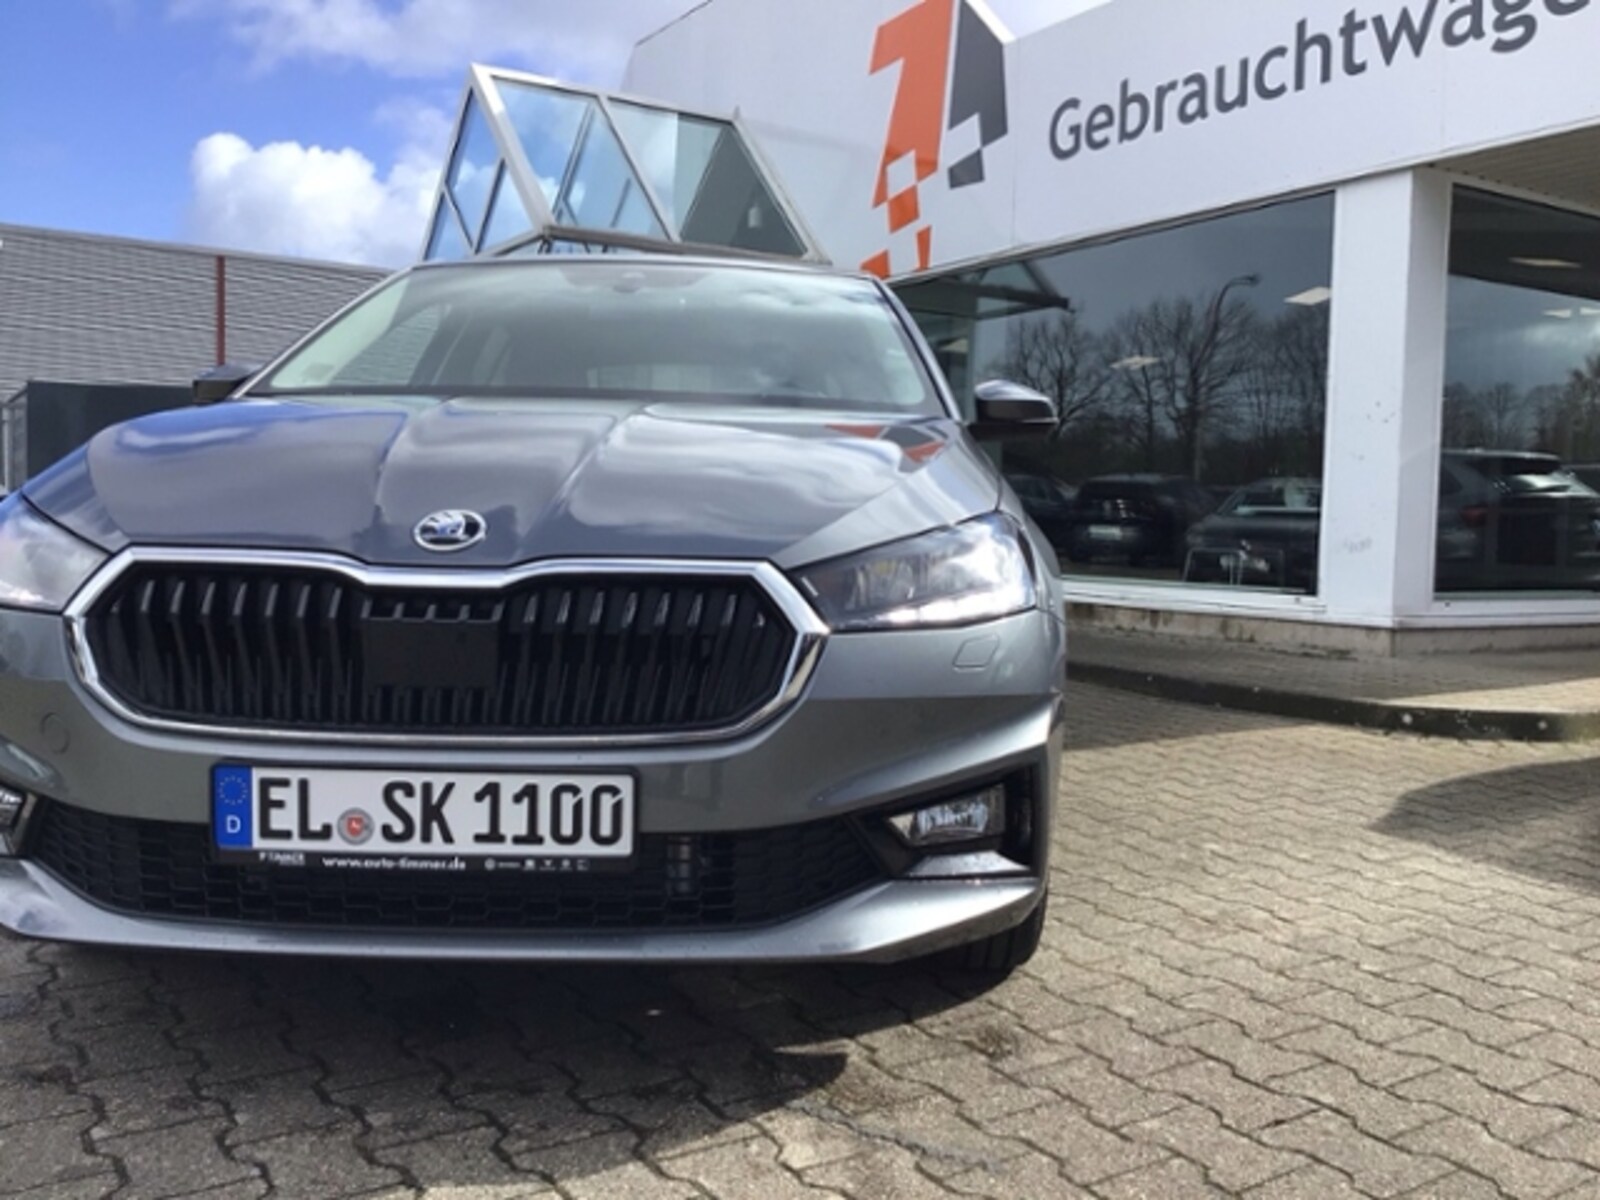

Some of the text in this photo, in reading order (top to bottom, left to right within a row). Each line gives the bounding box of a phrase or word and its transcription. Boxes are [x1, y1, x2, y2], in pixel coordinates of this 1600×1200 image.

[226, 815, 241, 834] D
[258, 777, 623, 847] EL SK 1100
